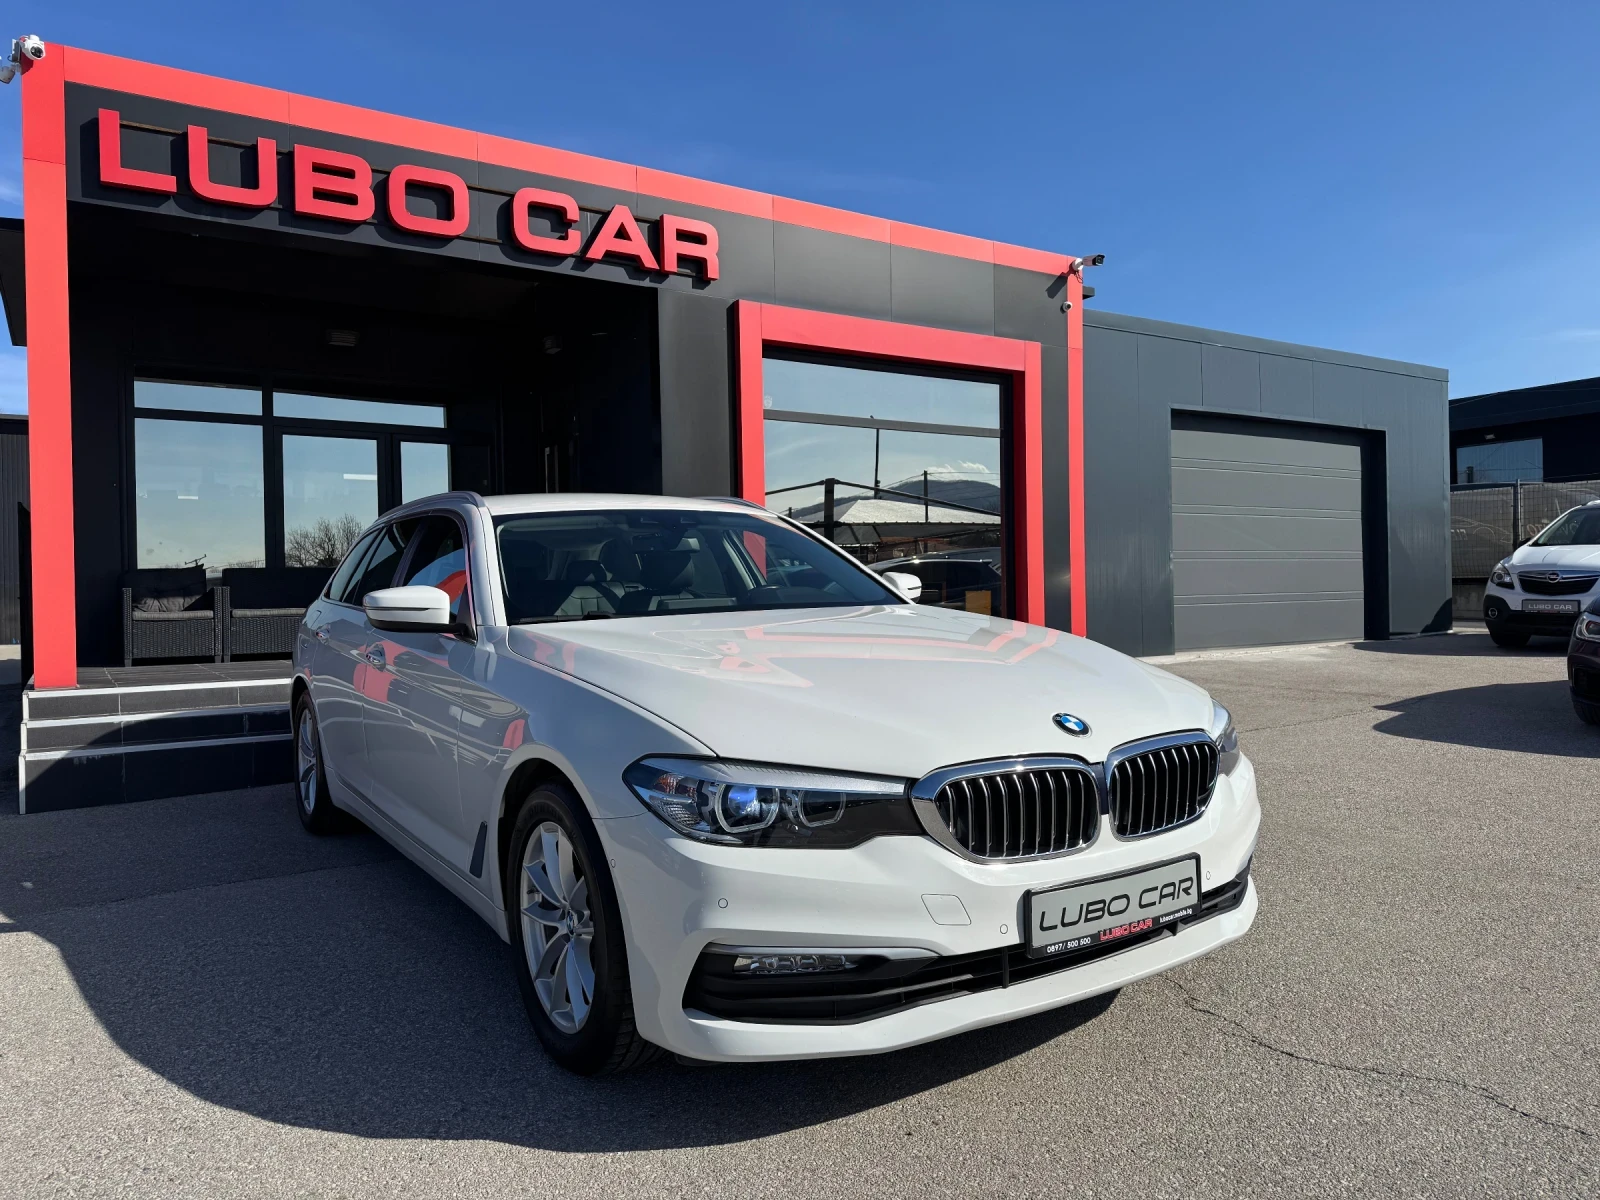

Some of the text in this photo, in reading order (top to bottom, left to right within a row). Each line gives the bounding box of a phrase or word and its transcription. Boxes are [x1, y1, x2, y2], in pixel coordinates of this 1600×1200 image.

[97, 108, 720, 281] LUBO CAR
[1039, 876, 1194, 931] LUBO CAR
[1067, 940, 1079, 949] 500
[1080, 937, 1091, 945] 500
[1099, 925, 1130, 941] LUBO
[1130, 918, 1153, 933] CAR
